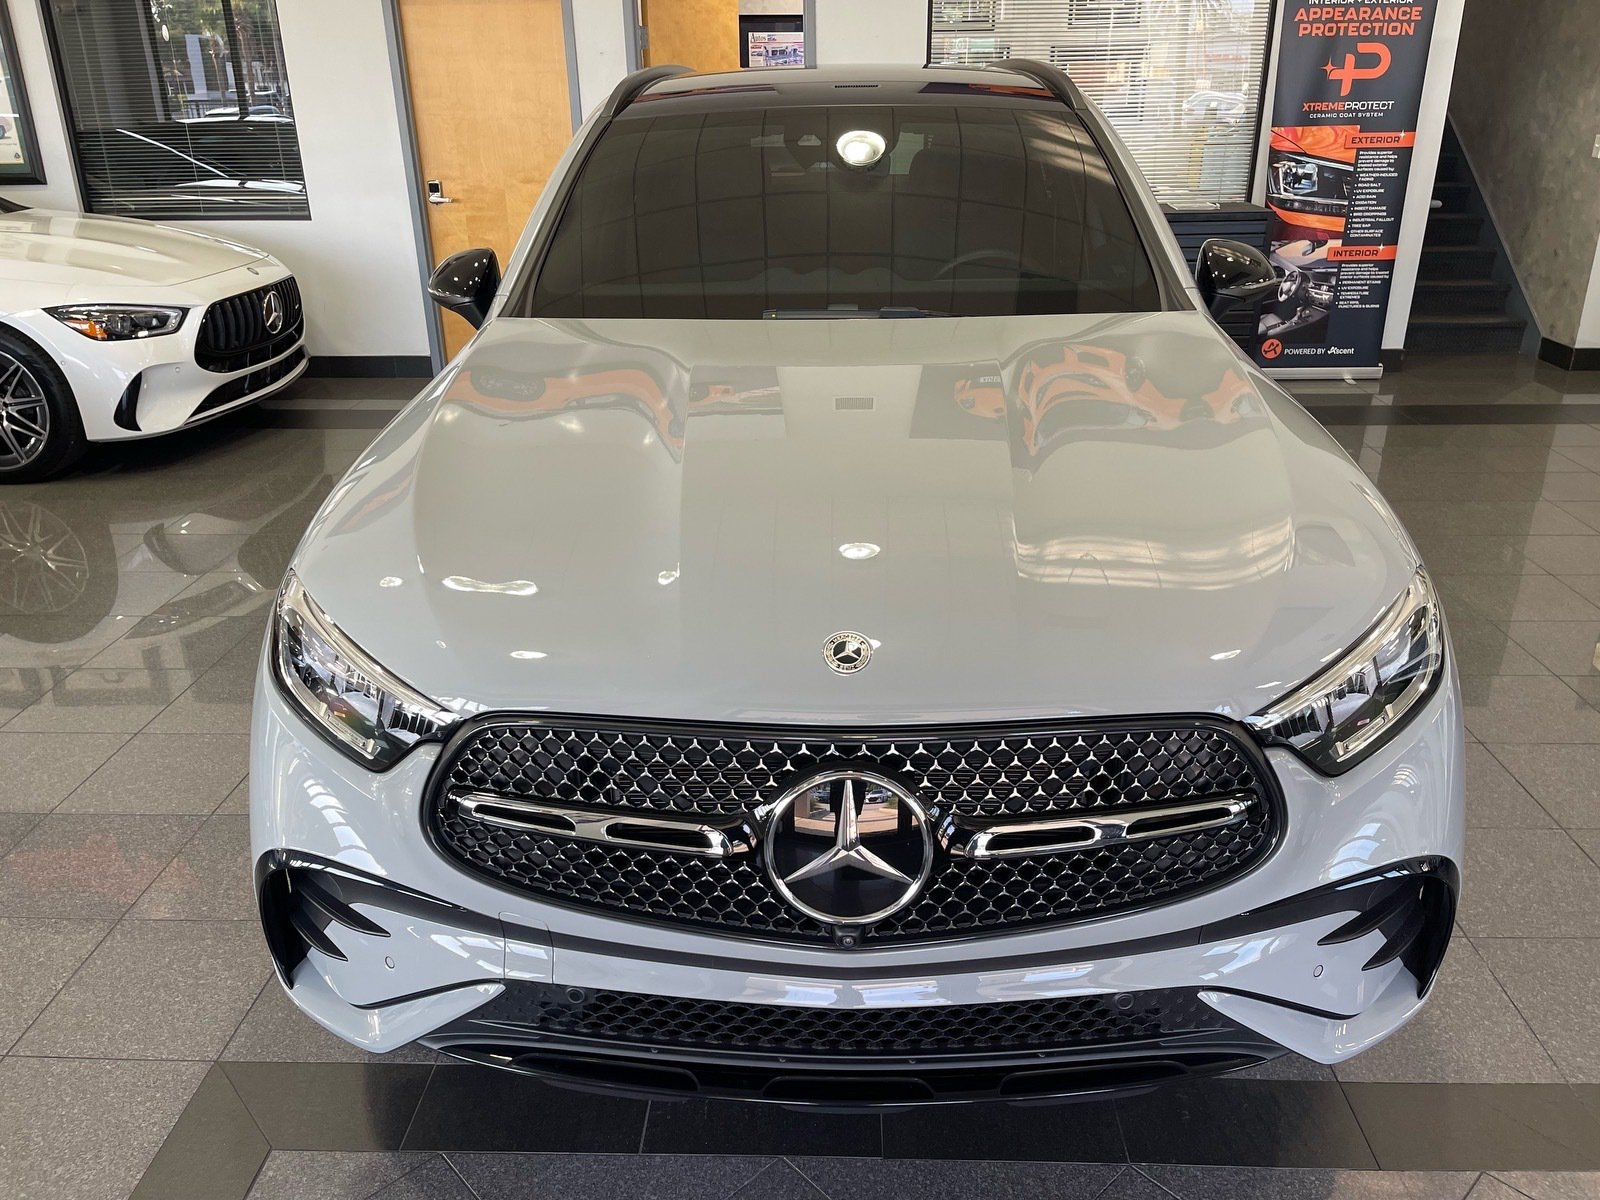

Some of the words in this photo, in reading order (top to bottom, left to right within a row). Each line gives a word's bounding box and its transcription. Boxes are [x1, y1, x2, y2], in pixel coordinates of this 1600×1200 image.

[1294, 7, 1423, 21] APPEARANCE
[1298, 22, 1415, 37] PROTECTION
[1302, 101, 1394, 111] XTREMEPROTECT
[1351, 136, 1400, 145] EXTERIOR
[1328, 346, 1355, 355] Ascent
